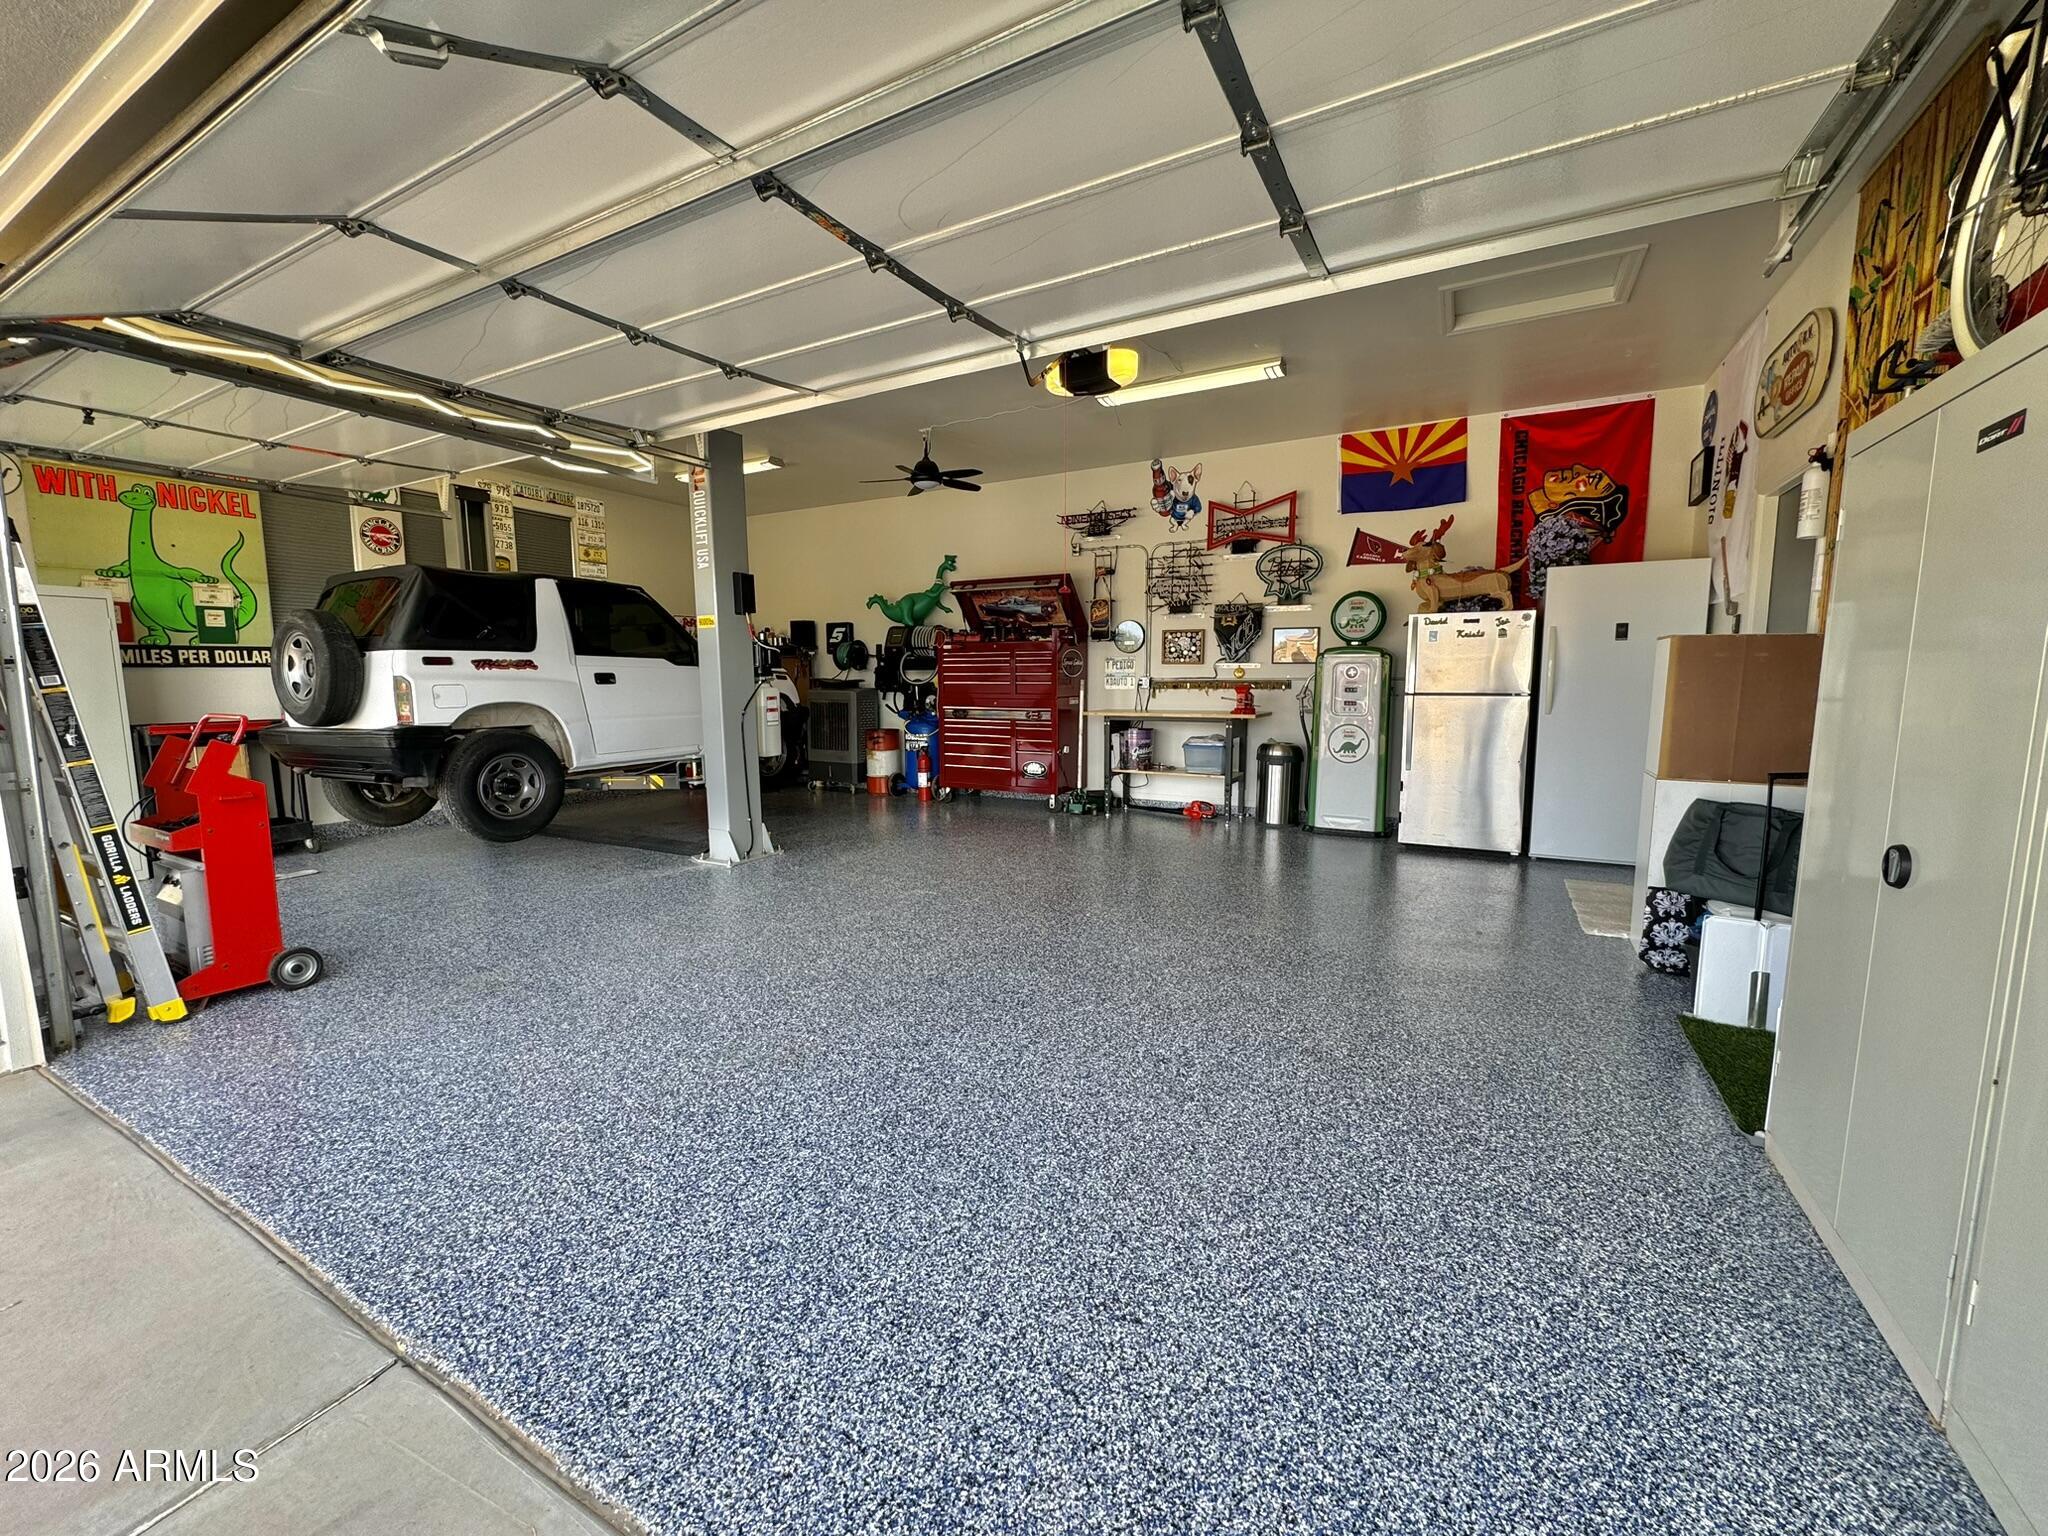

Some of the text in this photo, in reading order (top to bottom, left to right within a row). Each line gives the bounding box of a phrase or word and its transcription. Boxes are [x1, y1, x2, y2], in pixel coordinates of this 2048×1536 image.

[1512, 430, 1529, 495] CHICAGO
[32, 464, 257, 519] WITH NICKEL
[363, 519, 398, 534] SINCLAIR
[693, 490, 708, 546] QUICKLIFT
[363, 536, 401, 554] AIRCRAFT
[695, 547, 710, 570] USA
[121, 648, 272, 666] MILES PER DOLLAR
[470, 658, 539, 671] TRACKER
[101, 834, 124, 873] GORILLA
[119, 885, 143, 926] LADDERS
